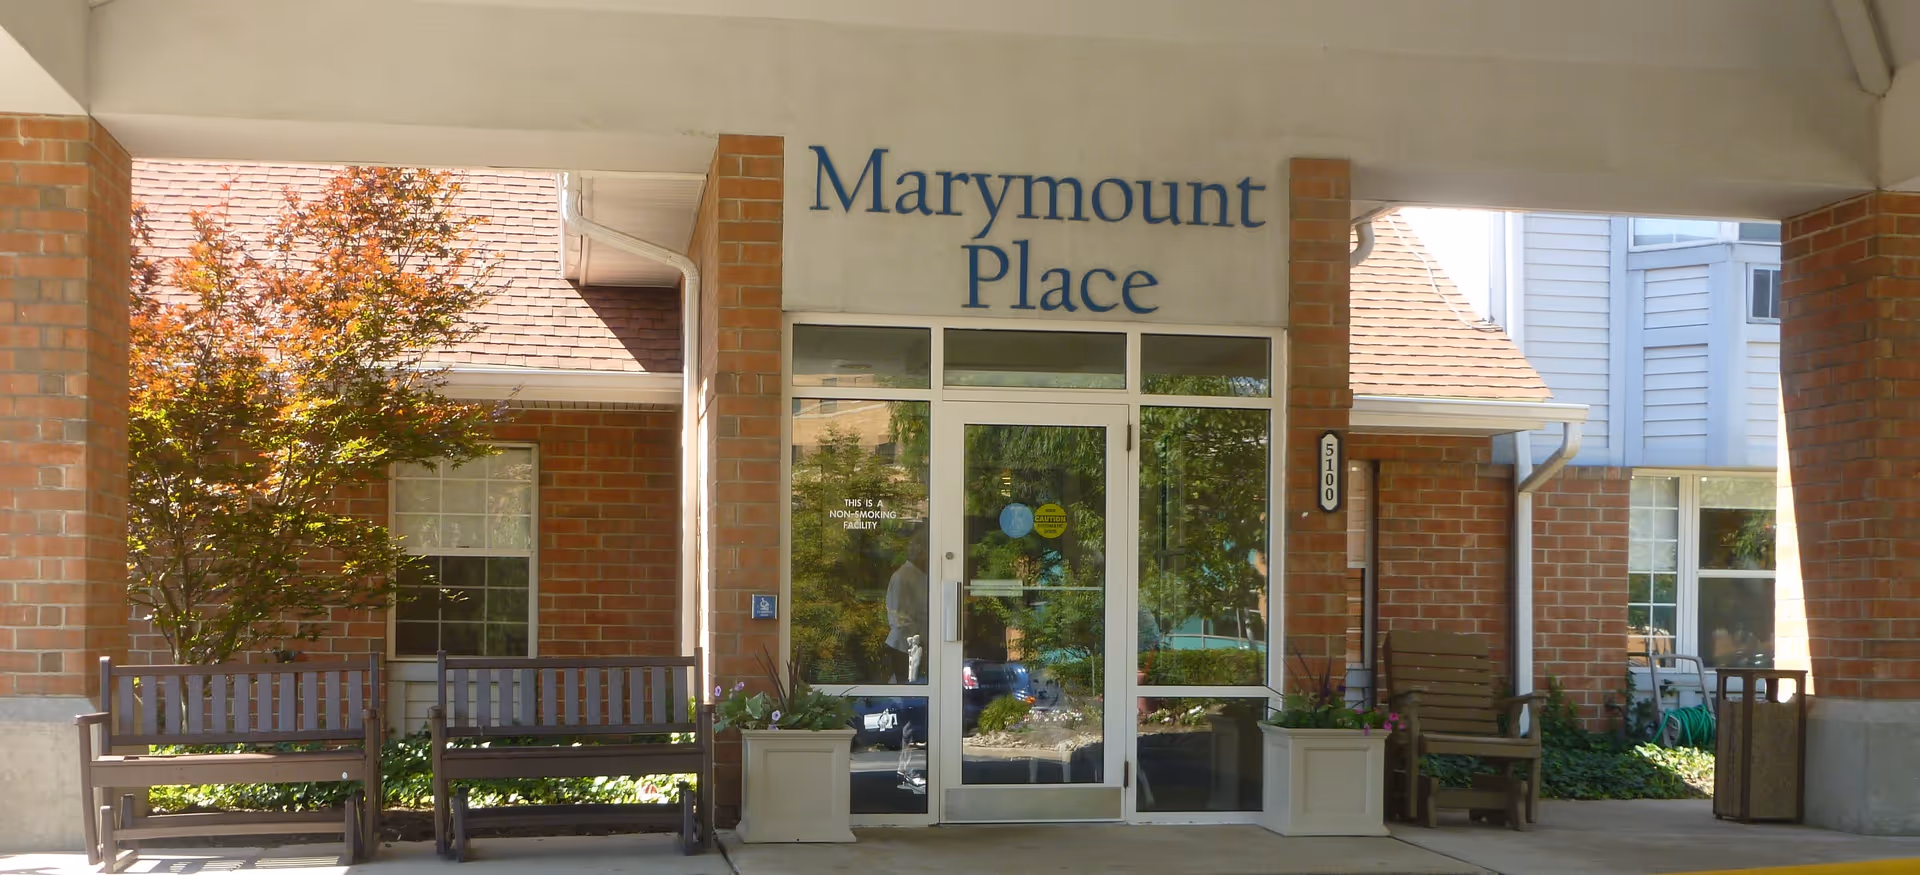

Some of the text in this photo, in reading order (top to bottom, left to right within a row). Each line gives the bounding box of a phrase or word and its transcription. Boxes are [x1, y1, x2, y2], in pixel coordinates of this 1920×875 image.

[808, 145, 1266, 239] Marymount
[961, 240, 1160, 314] Place
[1325, 443, 1334, 501] 5100
[844, 499, 884, 508] THIS IS A
[829, 510, 897, 519] NON-SMOKING
[1034, 515, 1067, 523] CAUTION
[843, 521, 878, 530] FACILITY
